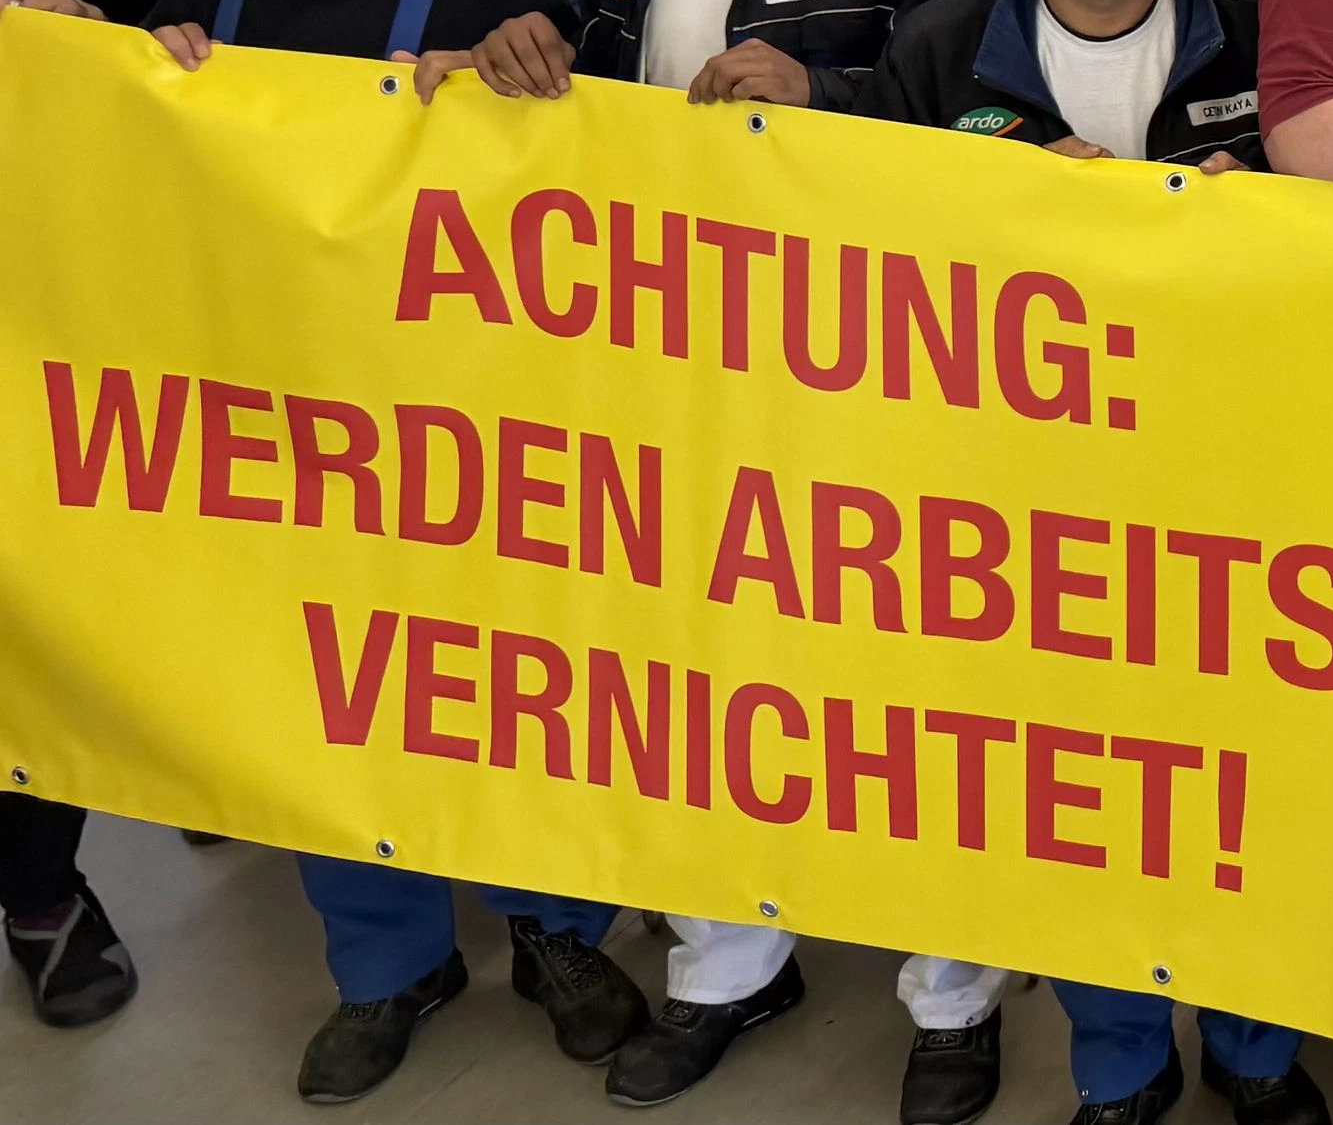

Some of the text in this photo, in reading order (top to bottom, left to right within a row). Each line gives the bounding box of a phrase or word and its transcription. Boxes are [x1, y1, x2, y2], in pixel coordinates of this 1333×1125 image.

[959, 113, 1004, 130] ardo
[394, 187, 1138, 431] ACHTUNG:
[43, 361, 661, 588] WERDEN
[302, 602, 1250, 893] VERNICHTET!
